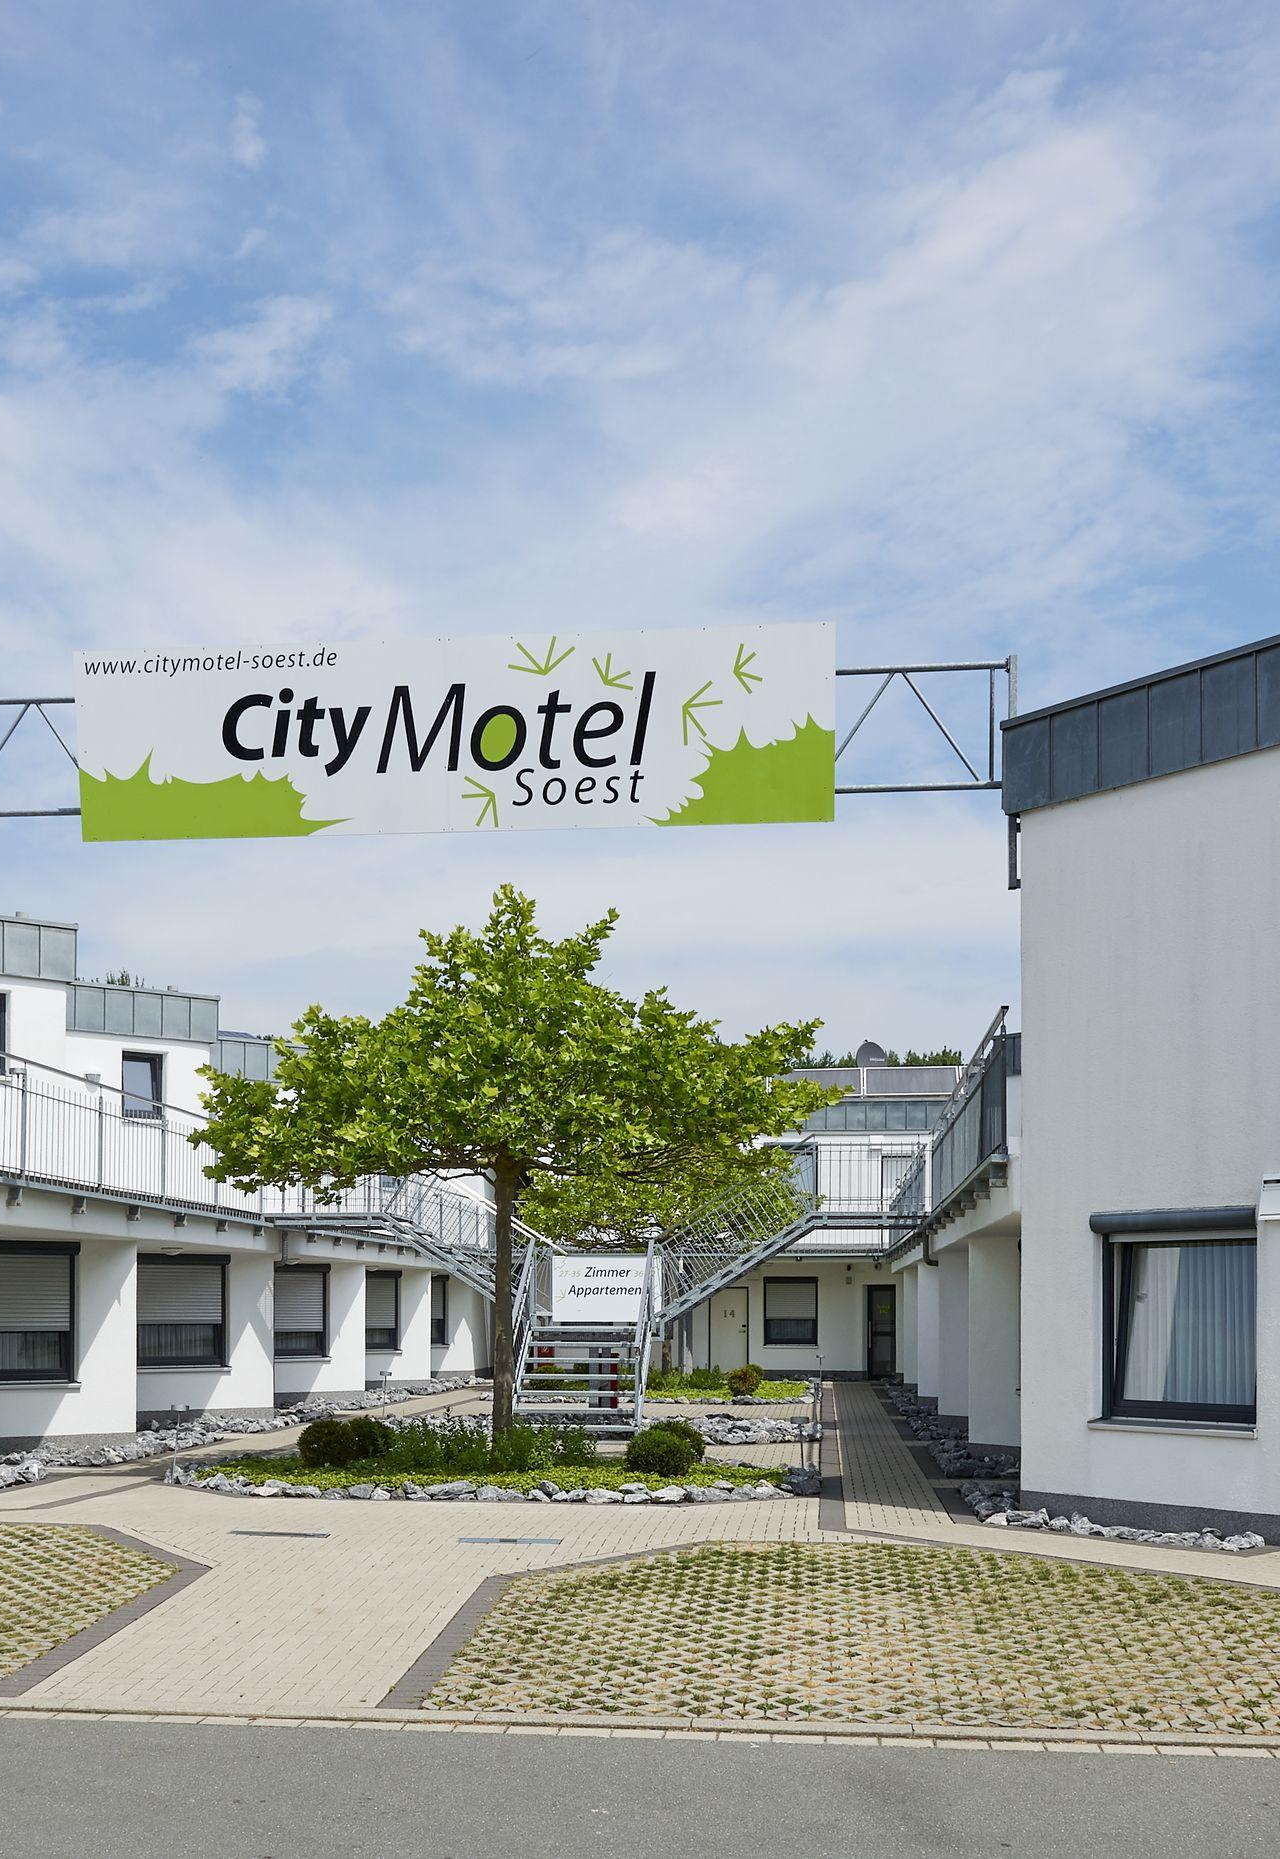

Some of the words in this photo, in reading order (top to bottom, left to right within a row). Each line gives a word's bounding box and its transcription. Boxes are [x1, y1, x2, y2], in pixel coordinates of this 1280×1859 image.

[83, 647, 338, 678] www.citymotel-soest.de
[512, 768, 645, 806] Soest
[584, 1266, 631, 1278] Zimmer
[567, 1284, 642, 1298] Appartemen
